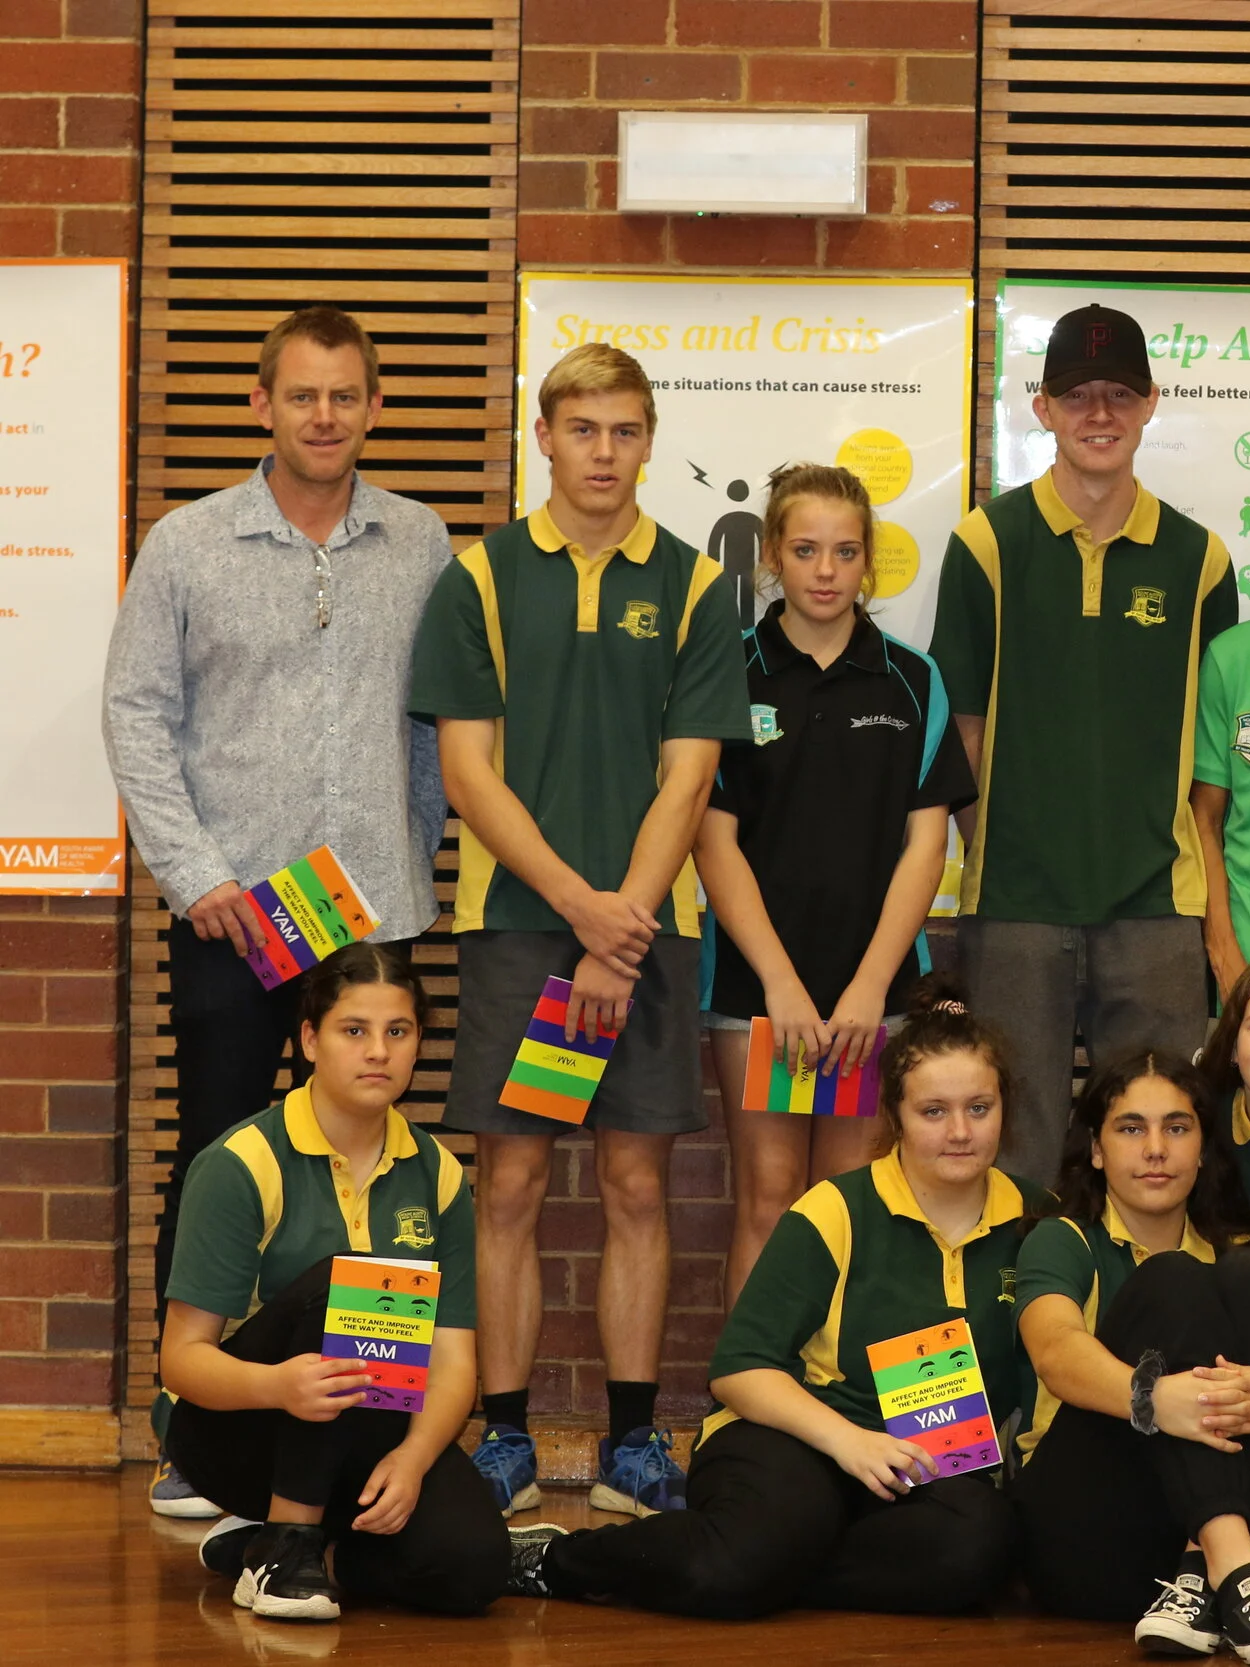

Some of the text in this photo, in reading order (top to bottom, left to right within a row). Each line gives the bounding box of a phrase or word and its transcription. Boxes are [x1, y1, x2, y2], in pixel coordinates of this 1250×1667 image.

[551, 313, 883, 354] Stress and Crisis
[1148, 323, 1208, 369] elp
[674, 378, 752, 391] situations
[756, 379, 788, 392] that
[792, 382, 818, 392] can
[823, 382, 867, 393] cause
[871, 382, 921, 394] stress:
[1174, 385, 1202, 398] feel
[6, 421, 44, 434] act in
[16, 486, 49, 498] your
[27, 546, 74, 558] stress,
[0, 845, 59, 867] YAM
[281, 888, 319, 944] THE WAY YOU FEEL
[284, 881, 327, 945] AFFECT AND IMPROVE
[271, 906, 300, 944] YAM
[557, 1056, 577, 1067] YAM
[338, 1315, 421, 1331] AFFECT AND IMPROVE
[343, 1323, 414, 1337] THE WAY YOU FEEL
[354, 1340, 397, 1360] YAM
[891, 1377, 968, 1404] AFFECT AND IMPROVE
[897, 1386, 964, 1409] THE WAY YOU FEEL
[914, 1405, 957, 1429] YAM
